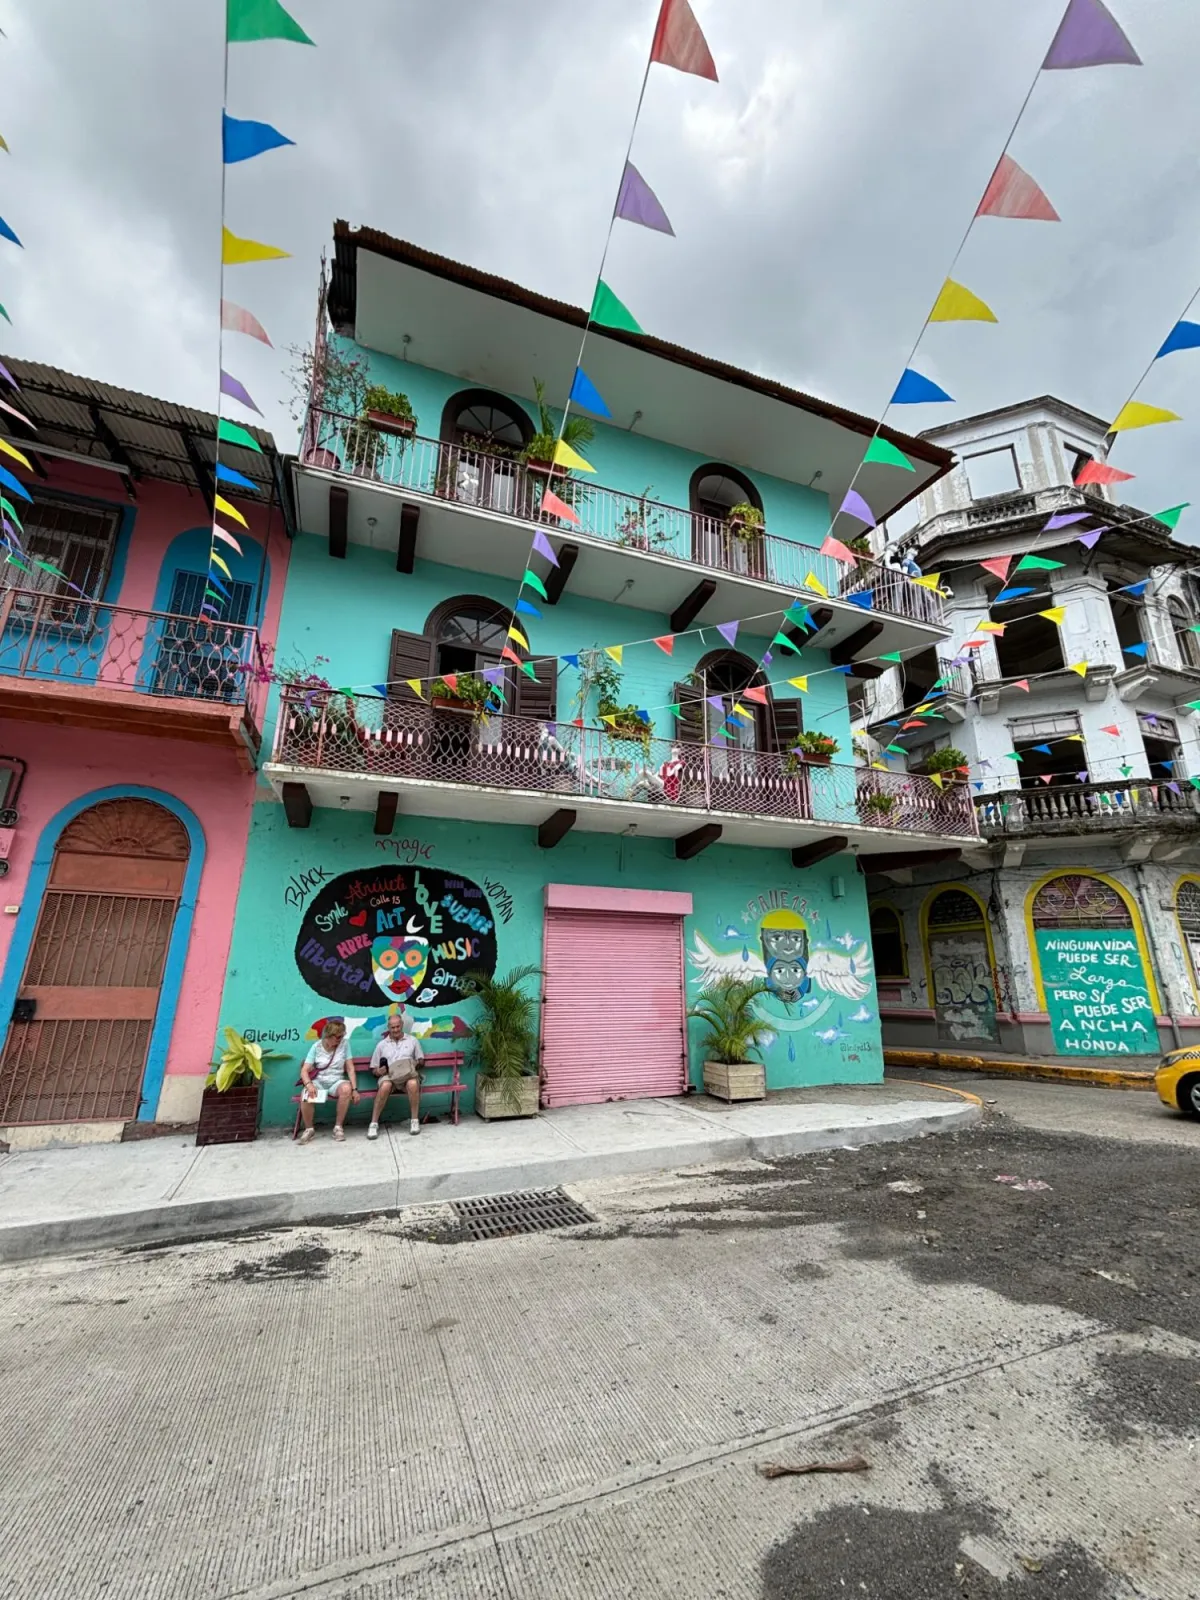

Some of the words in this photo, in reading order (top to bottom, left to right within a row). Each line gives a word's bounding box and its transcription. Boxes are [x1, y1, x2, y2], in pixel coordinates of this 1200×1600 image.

[284, 865, 335, 912] BLACK
[413, 870, 444, 934] LOVE
[483, 876, 515, 925] WOMAN
[314, 901, 349, 932] Smile
[336, 933, 373, 960] HOPE
[431, 937, 481, 965] MUSIC
[299, 937, 375, 993] libertad
[1057, 952, 1099, 964] PUEDE
[1103, 952, 1138, 969] SER
[1053, 989, 1087, 1002] PERO
[1073, 1002, 1120, 1018] PUEDE
[1121, 995, 1153, 1014] SER
[1059, 1019, 1149, 1034] ANCHA
[1065, 1038, 1131, 1053] HONDA
